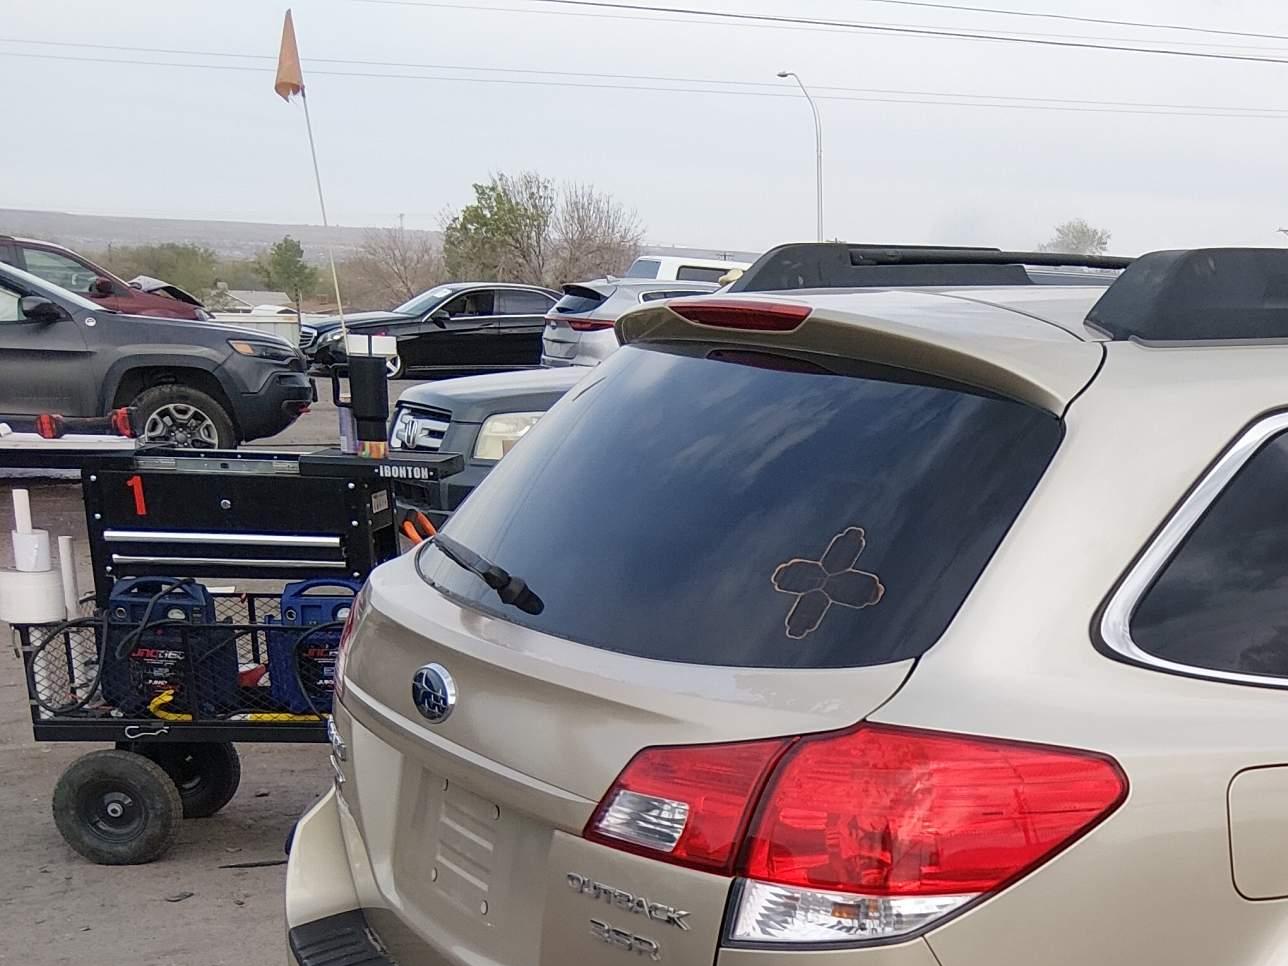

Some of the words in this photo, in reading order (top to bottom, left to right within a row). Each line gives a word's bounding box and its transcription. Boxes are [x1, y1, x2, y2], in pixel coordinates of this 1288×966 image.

[379, 465, 429, 479] IRONTON
[126, 475, 148, 516] 1
[566, 871, 692, 931] OUTBACK
